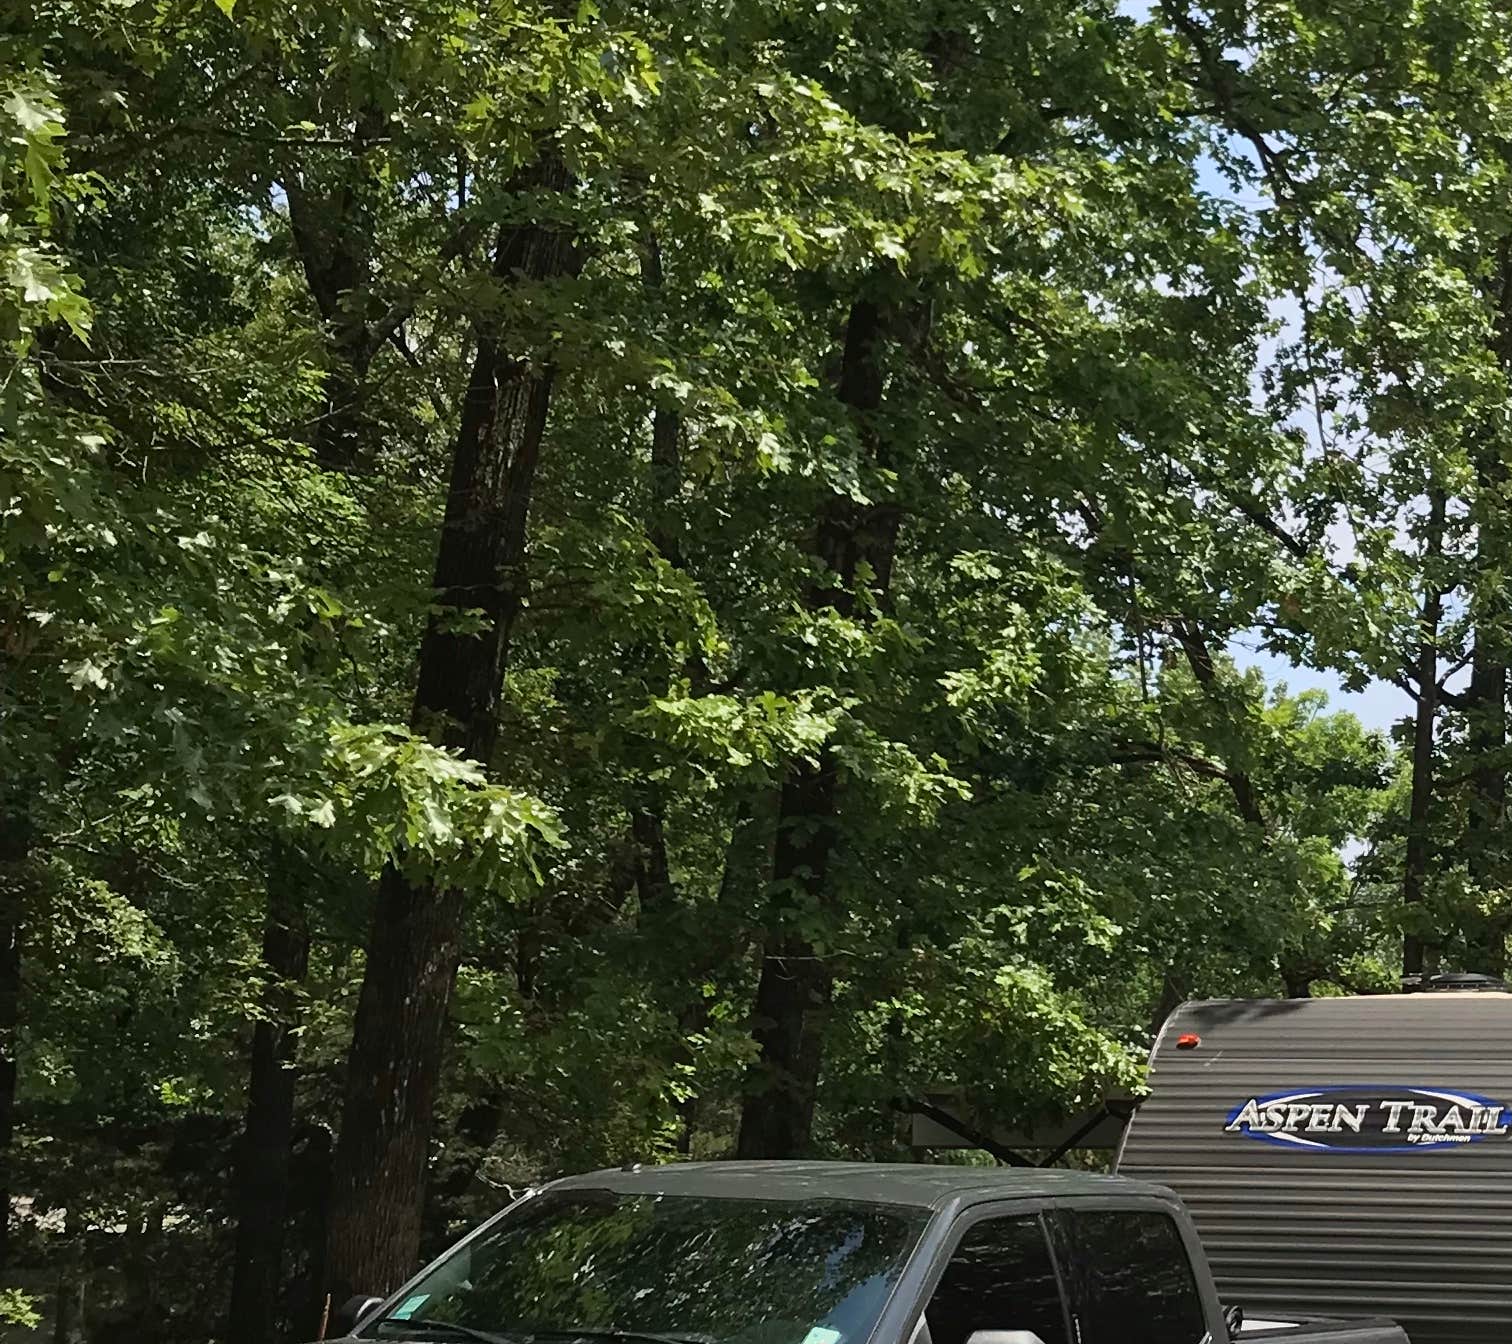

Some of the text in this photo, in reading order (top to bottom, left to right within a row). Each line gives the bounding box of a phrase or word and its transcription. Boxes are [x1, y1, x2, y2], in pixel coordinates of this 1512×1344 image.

[1225, 1099, 1508, 1134] ASPEN TRAIL
[1407, 1133, 1420, 1144] by
